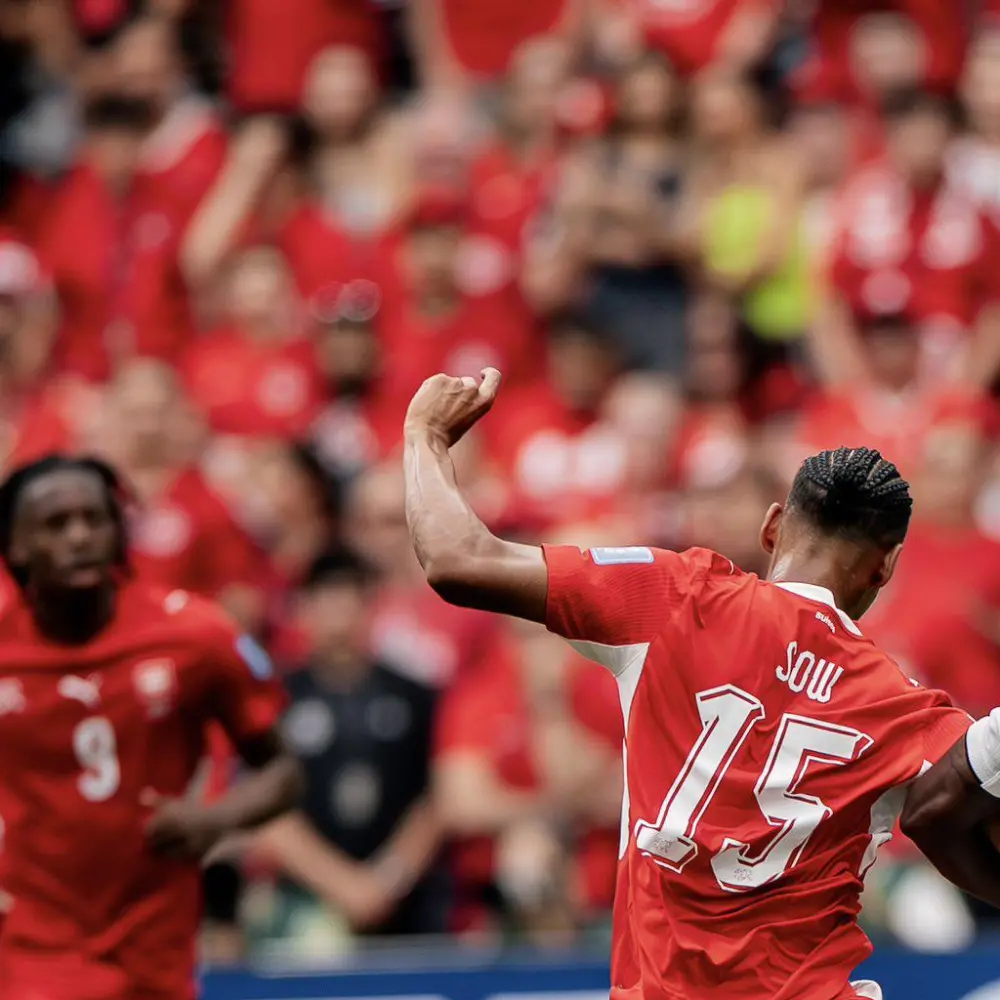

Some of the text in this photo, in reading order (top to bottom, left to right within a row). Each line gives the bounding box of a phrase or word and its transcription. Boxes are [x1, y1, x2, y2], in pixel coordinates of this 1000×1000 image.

[775, 640, 844, 703] SOW
[73, 715, 121, 802] 9
[634, 683, 875, 892] 15
